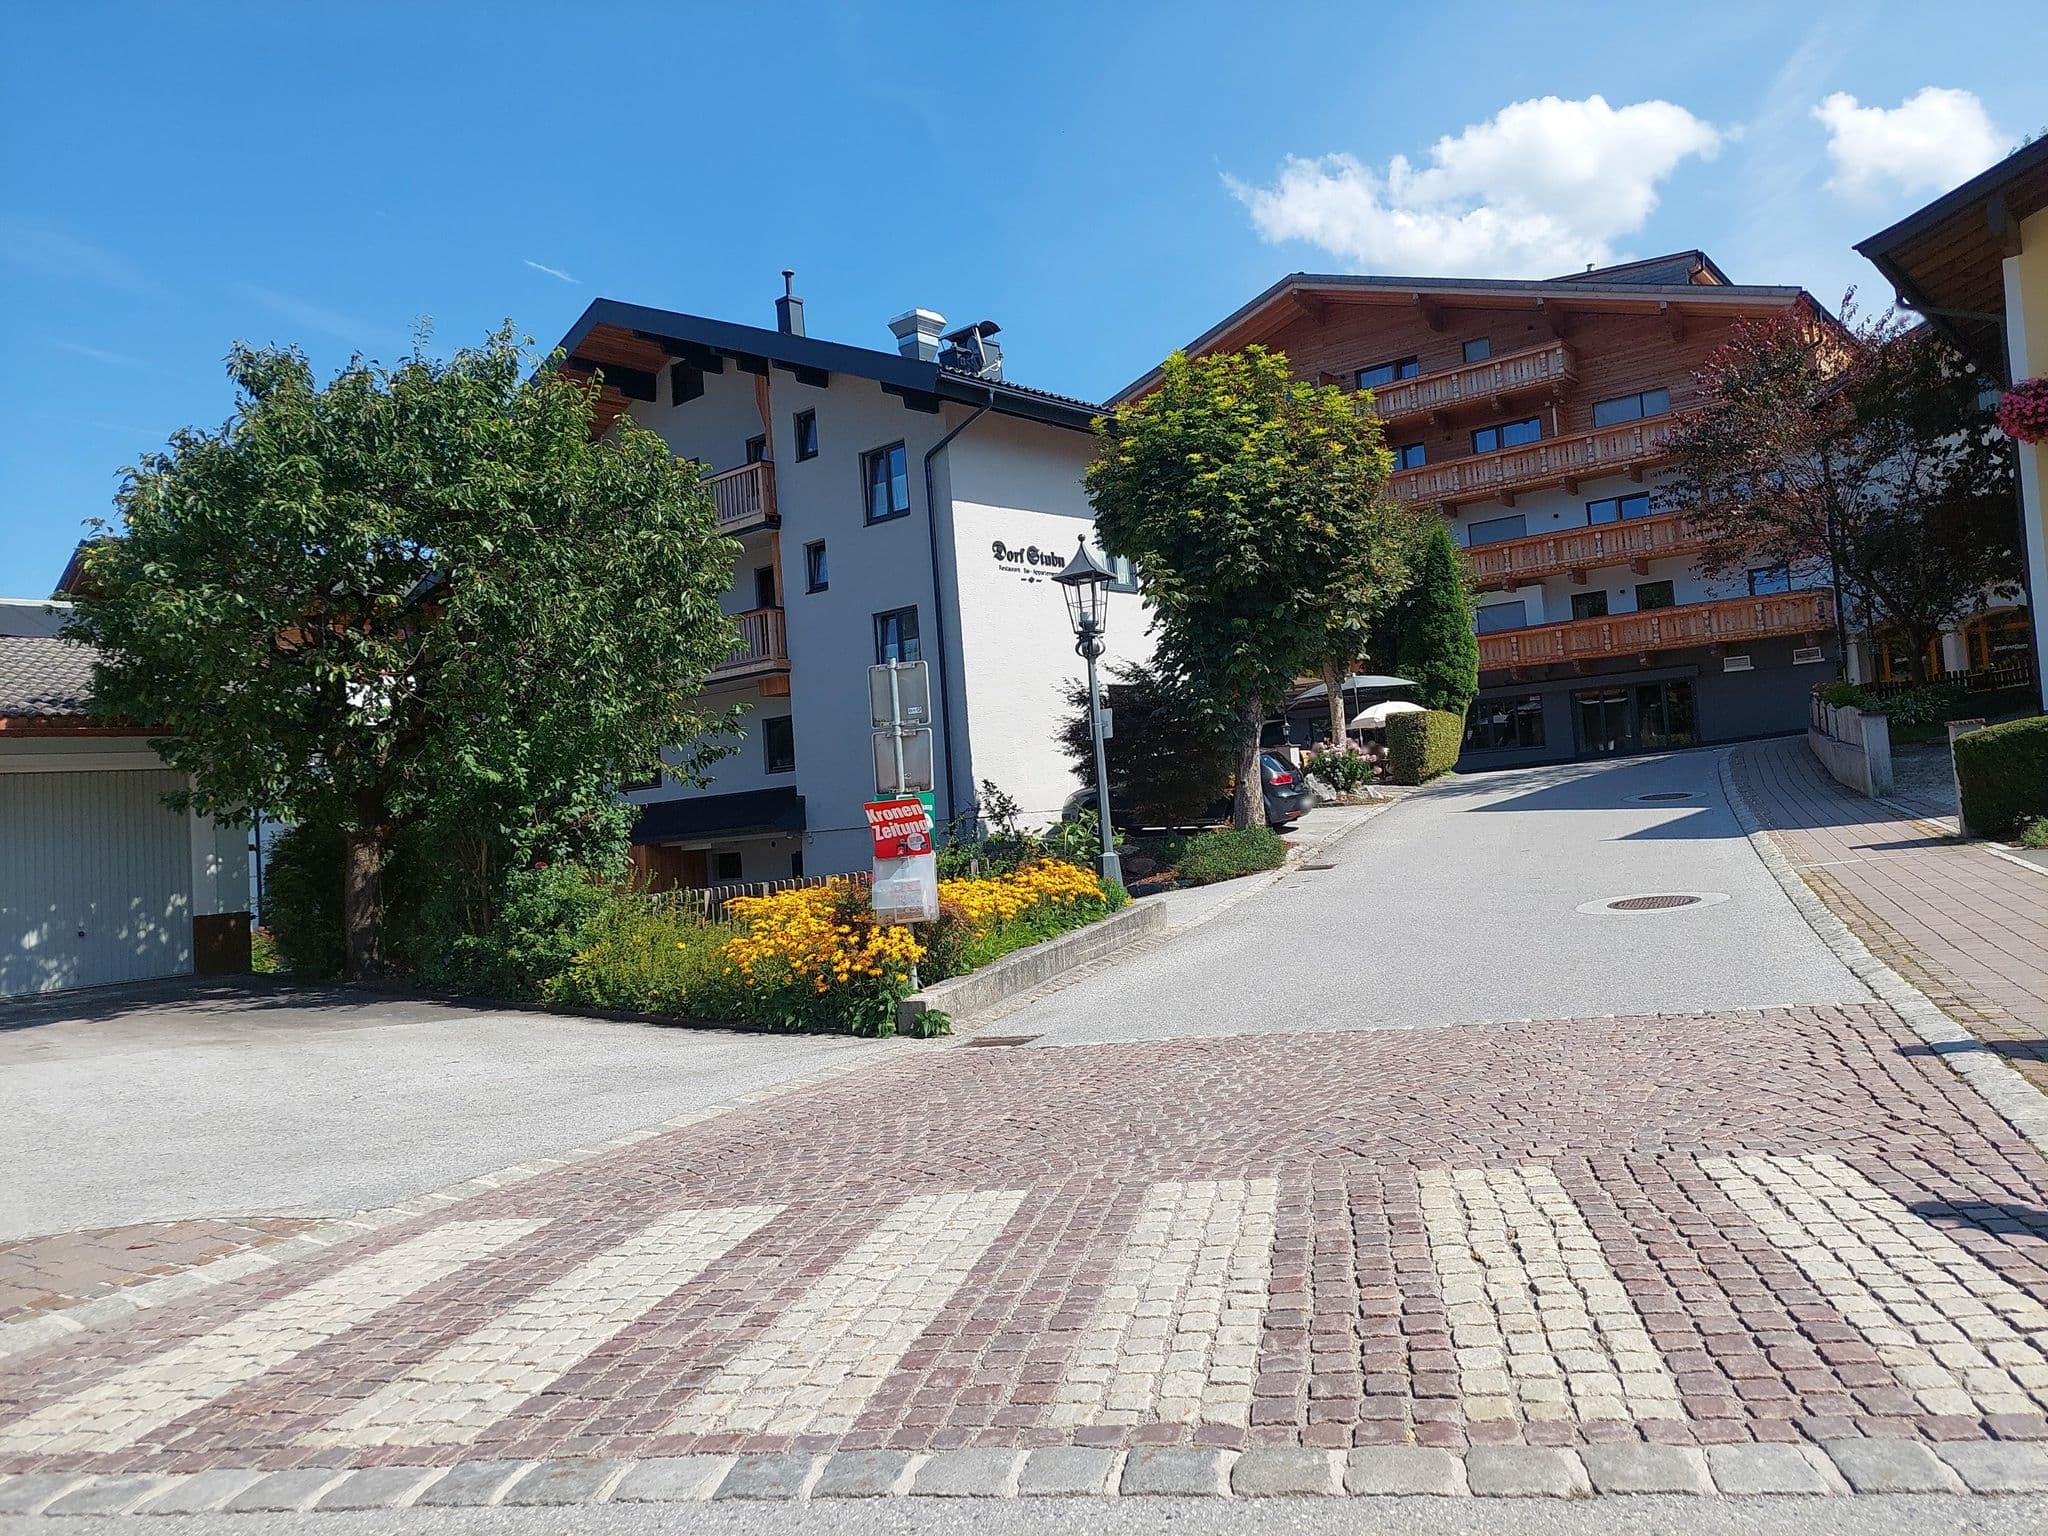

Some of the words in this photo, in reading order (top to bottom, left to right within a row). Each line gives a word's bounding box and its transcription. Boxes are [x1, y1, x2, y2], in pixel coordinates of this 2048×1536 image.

[992, 540, 1025, 564] Dorf
[1027, 545, 1065, 568] Stubn
[865, 804, 924, 823] Kronen
[872, 819, 929, 841] Zeitung
